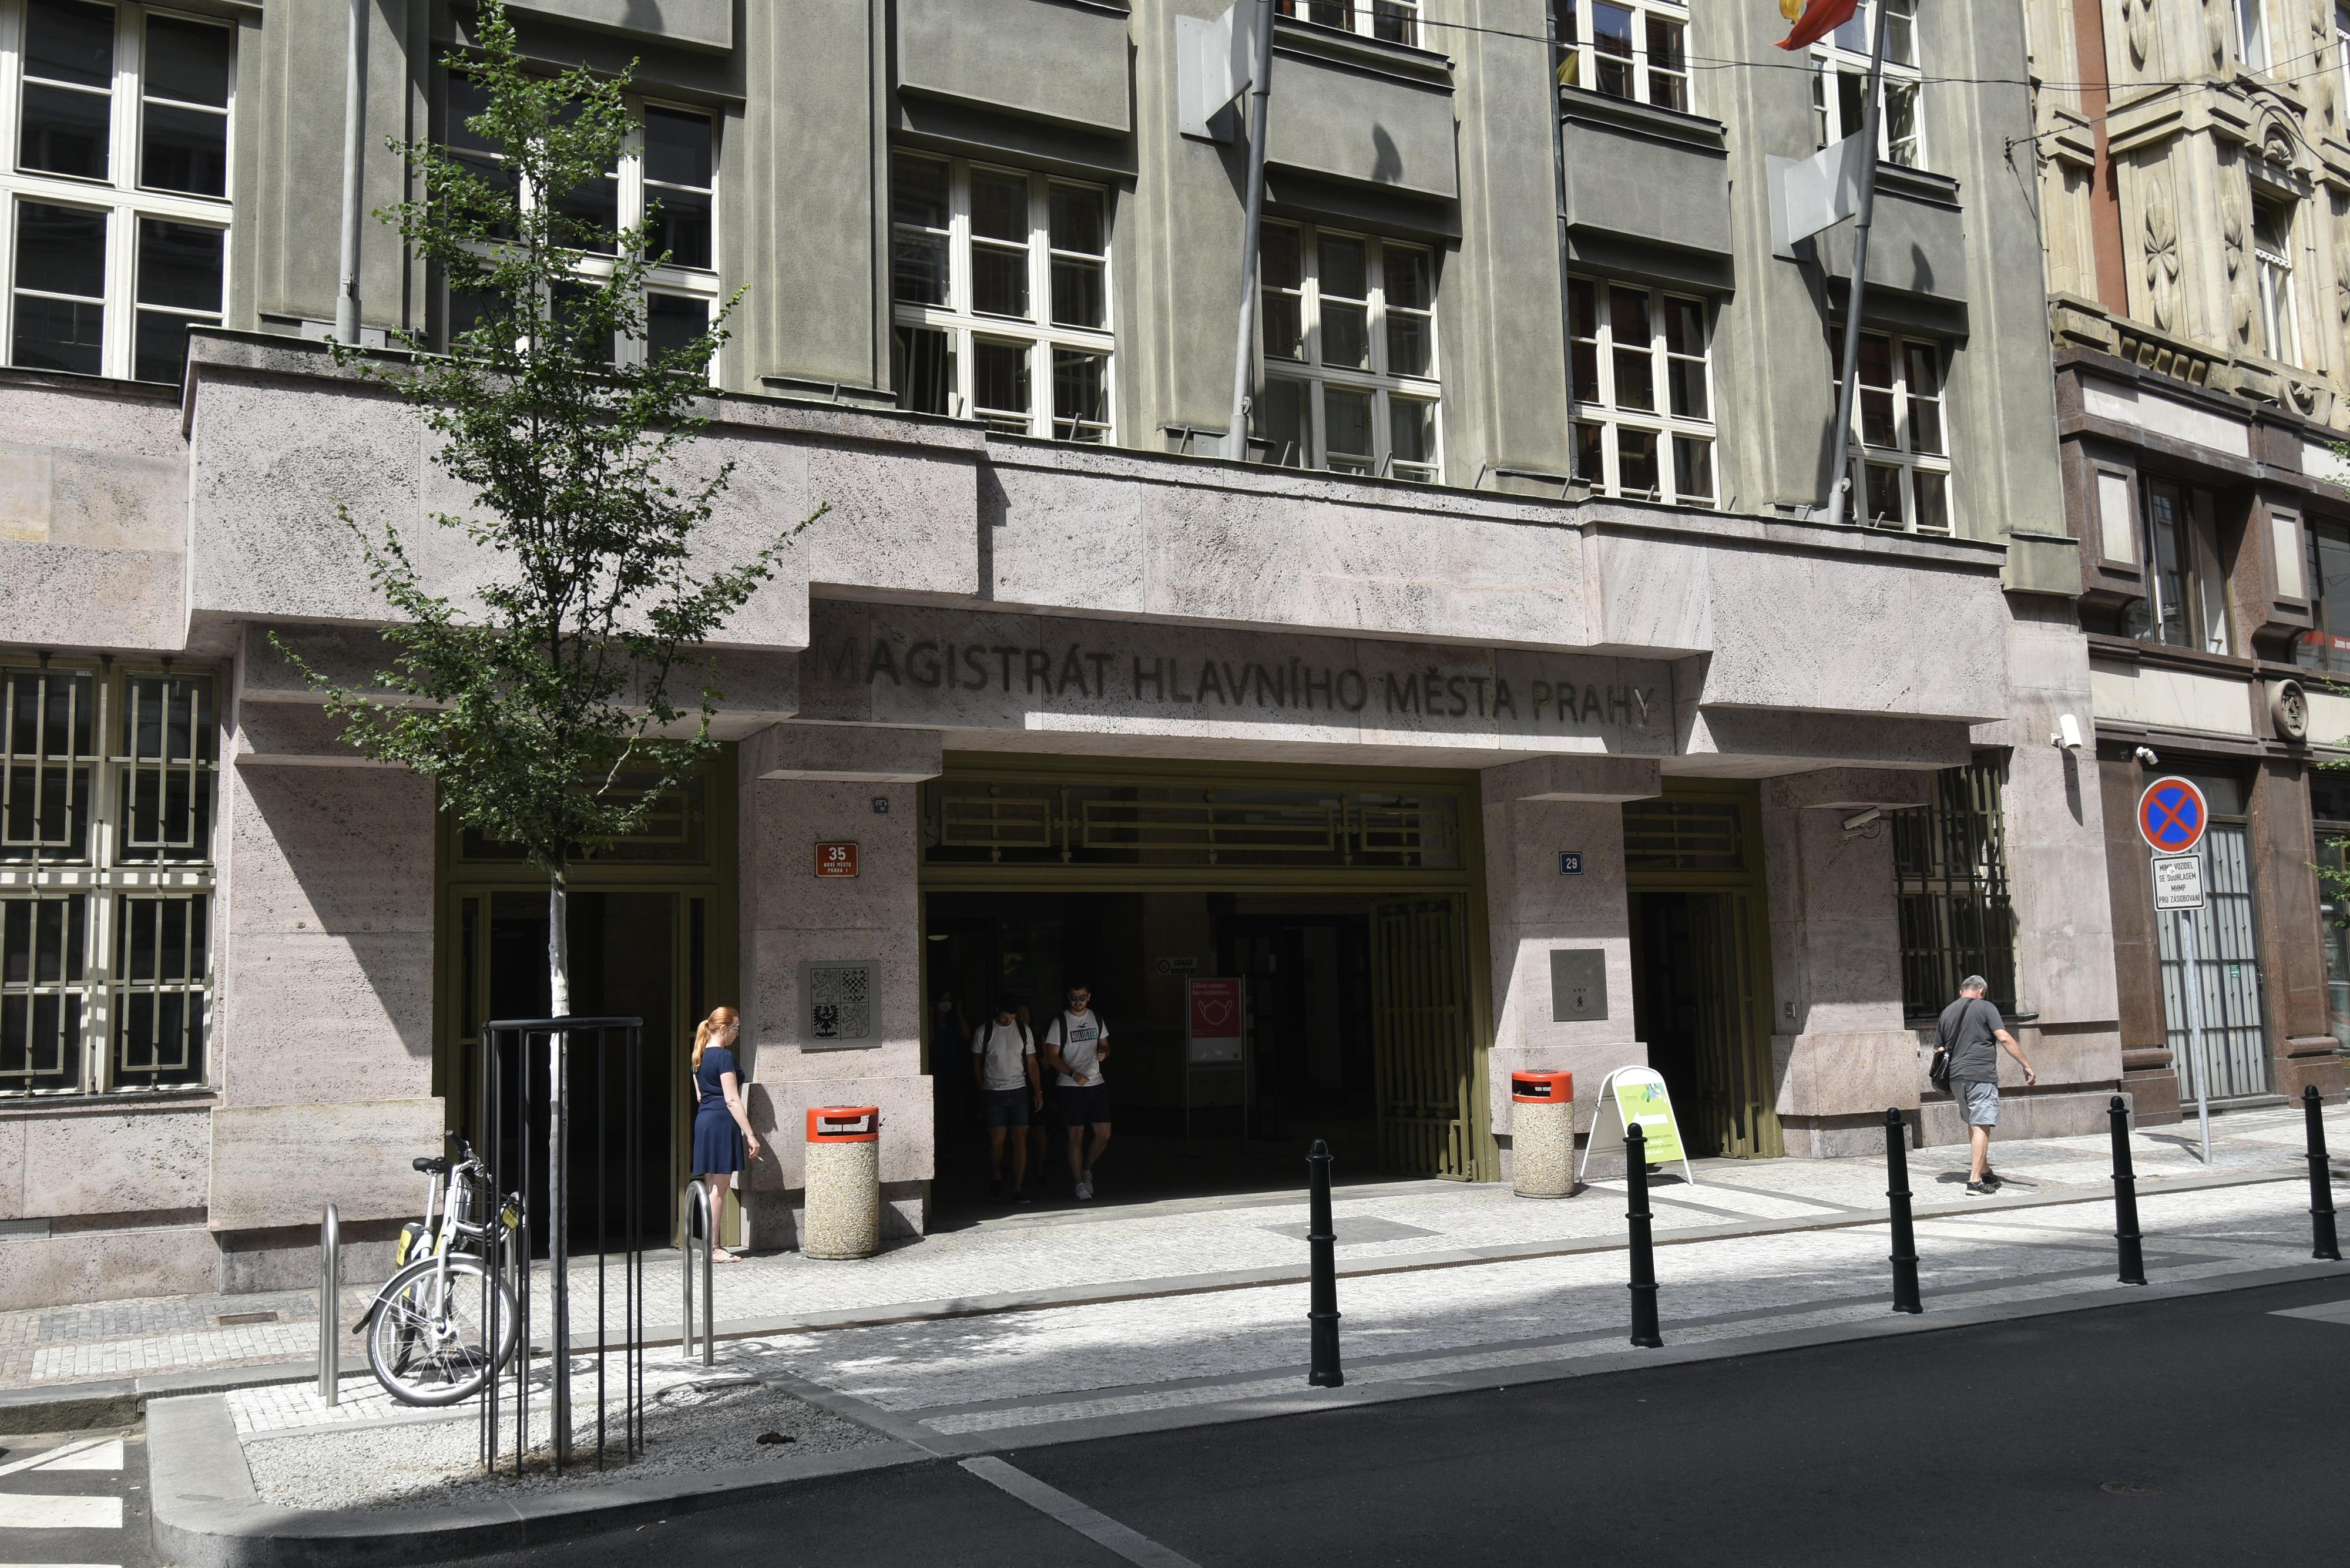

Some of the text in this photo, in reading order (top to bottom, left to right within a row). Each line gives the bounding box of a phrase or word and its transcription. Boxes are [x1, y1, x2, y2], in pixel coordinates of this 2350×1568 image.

[814, 635, 1655, 725] MAGISTRÁT HLAVNÍHO MĚSTA PRAHY
[828, 847, 847, 861] 35
[1566, 858, 1577, 869] 29
[2174, 862, 2194, 870] VOZIDEL
[2167, 872, 2196, 882] SOUHLASEM
[2171, 884, 2186, 892] MHMP
[1072, 1029, 1096, 1042] HOLLISTER
